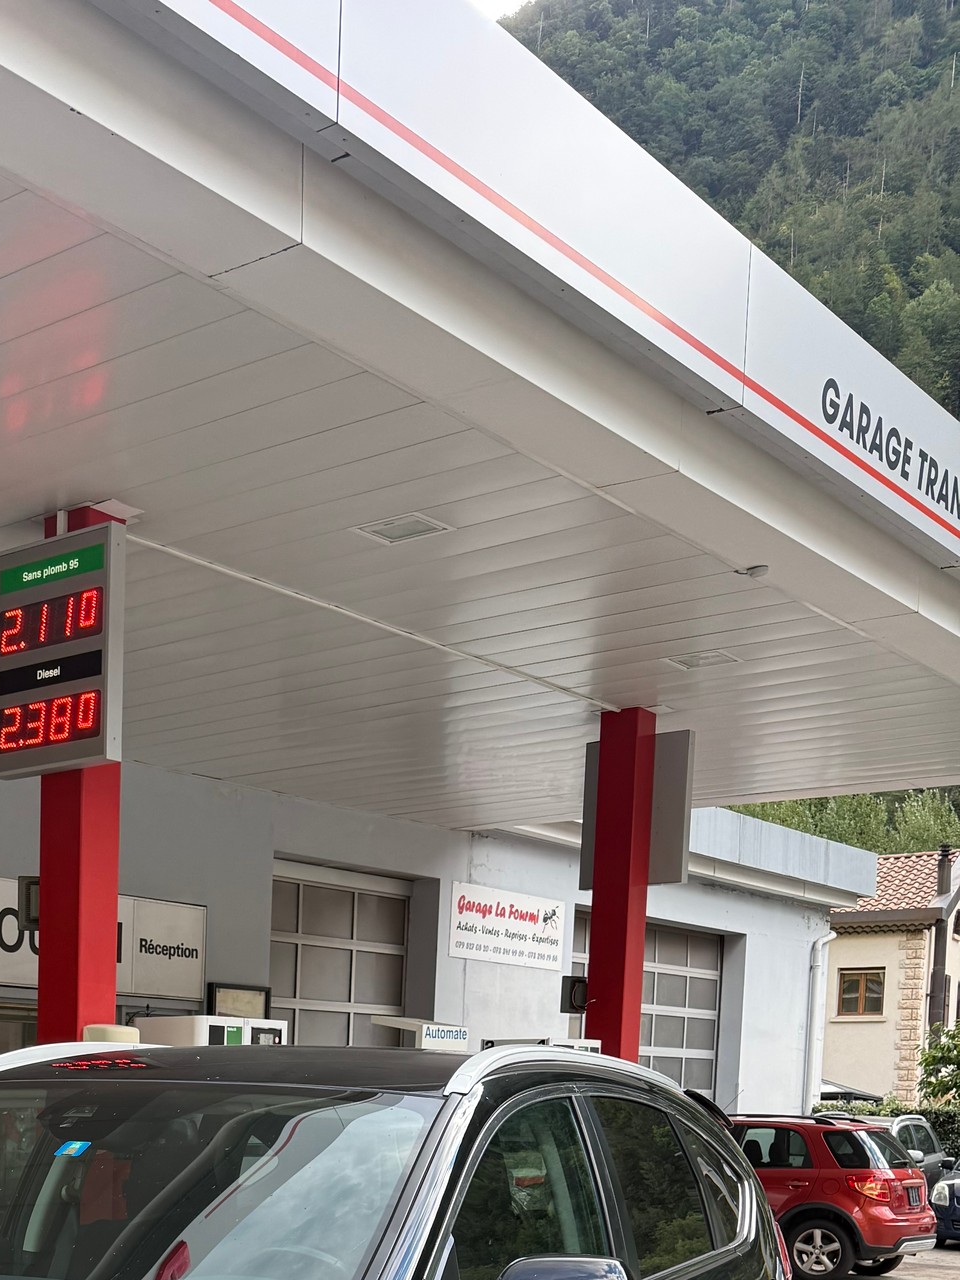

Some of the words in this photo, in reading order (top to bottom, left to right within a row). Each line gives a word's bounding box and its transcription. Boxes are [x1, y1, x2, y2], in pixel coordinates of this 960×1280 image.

[822, 378, 913, 482] GARAGE
[22, 569, 42, 582] Sans
[43, 562, 68, 578] plomb
[69, 558, 79, 570] 95
[0, 589, 98, 653] 2.110
[36, 666, 61, 680] Diesel
[0, 692, 97, 749] 2.380
[457, 895, 493, 919] Garage
[495, 901, 506, 918] La
[508, 903, 540, 925] Fourmi
[456, 921, 477, 934] Achats
[481, 925, 500, 938] Ventes
[504, 928, 528, 942] Reprises
[531, 933, 559, 947] Expertises
[139, 937, 199, 959] Réception
[425, 1026, 467, 1040] Automate
